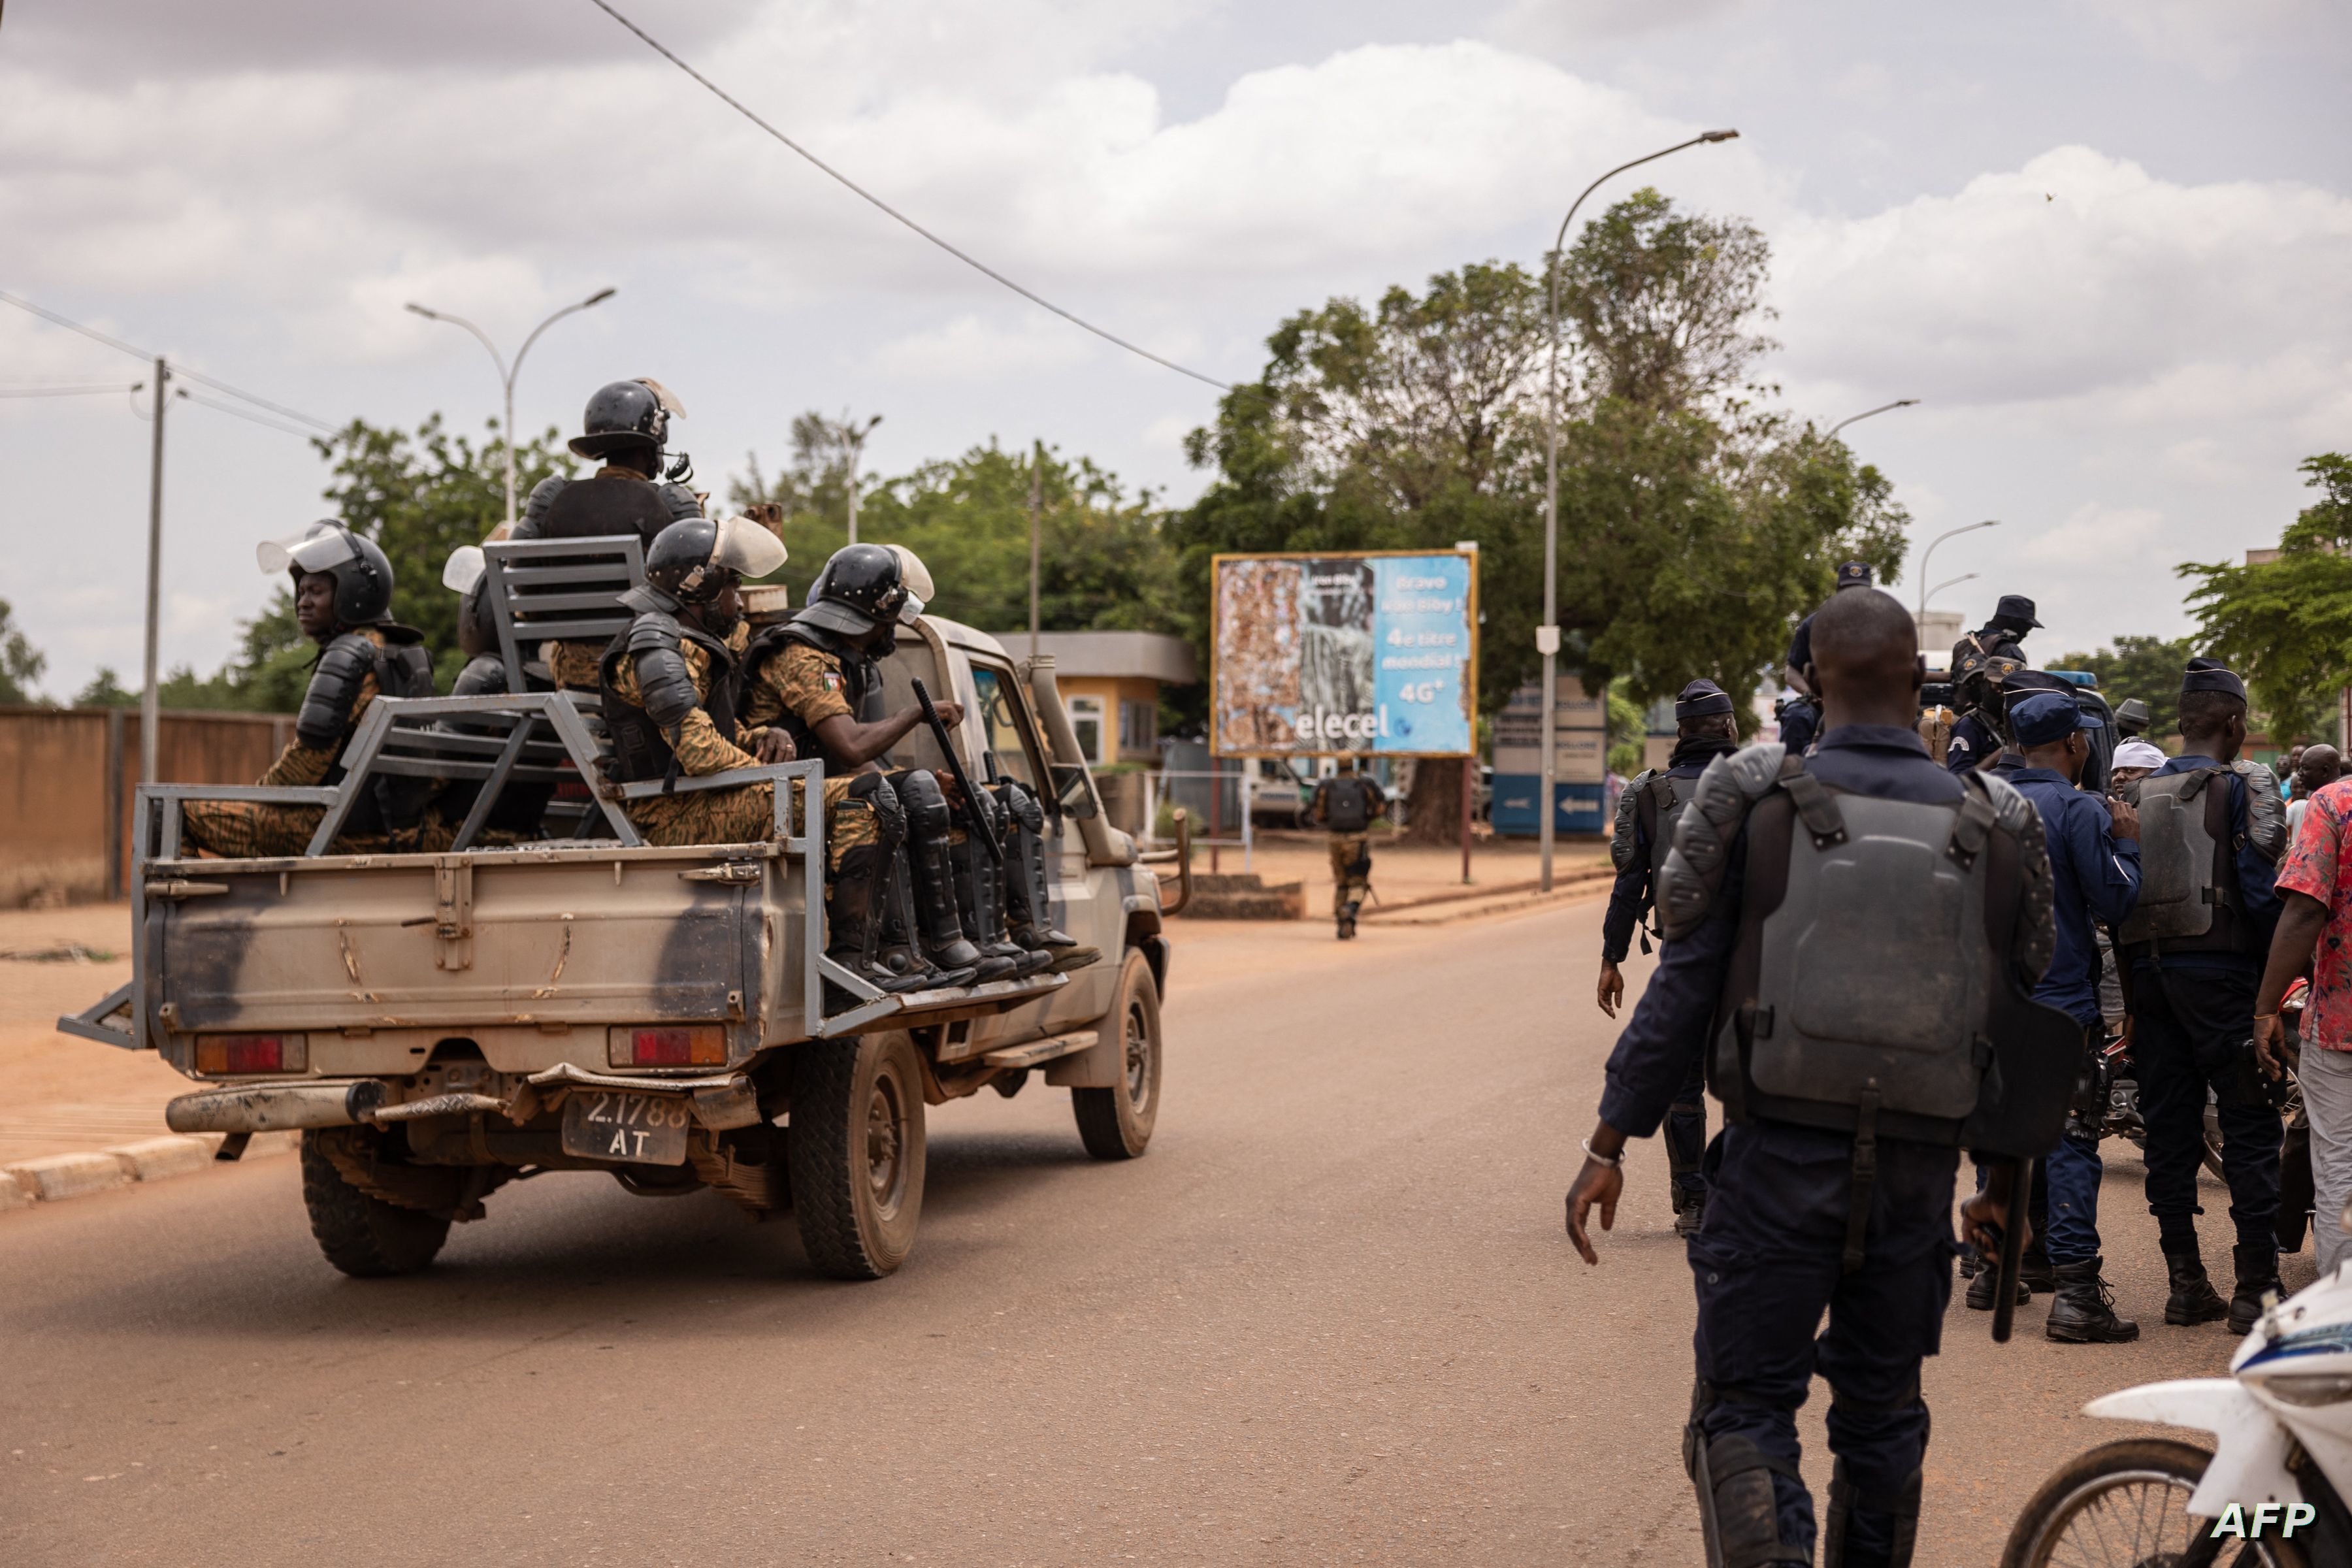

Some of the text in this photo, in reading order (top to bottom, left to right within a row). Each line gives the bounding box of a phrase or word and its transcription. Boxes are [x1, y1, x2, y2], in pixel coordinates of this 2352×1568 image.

[1396, 576, 1446, 590] Bravo
[1418, 598, 1453, 615] Biby
[1386, 628, 1456, 648] 4e titre
[1382, 652, 1452, 670] mondial
[609, 1128, 651, 1157] AT
